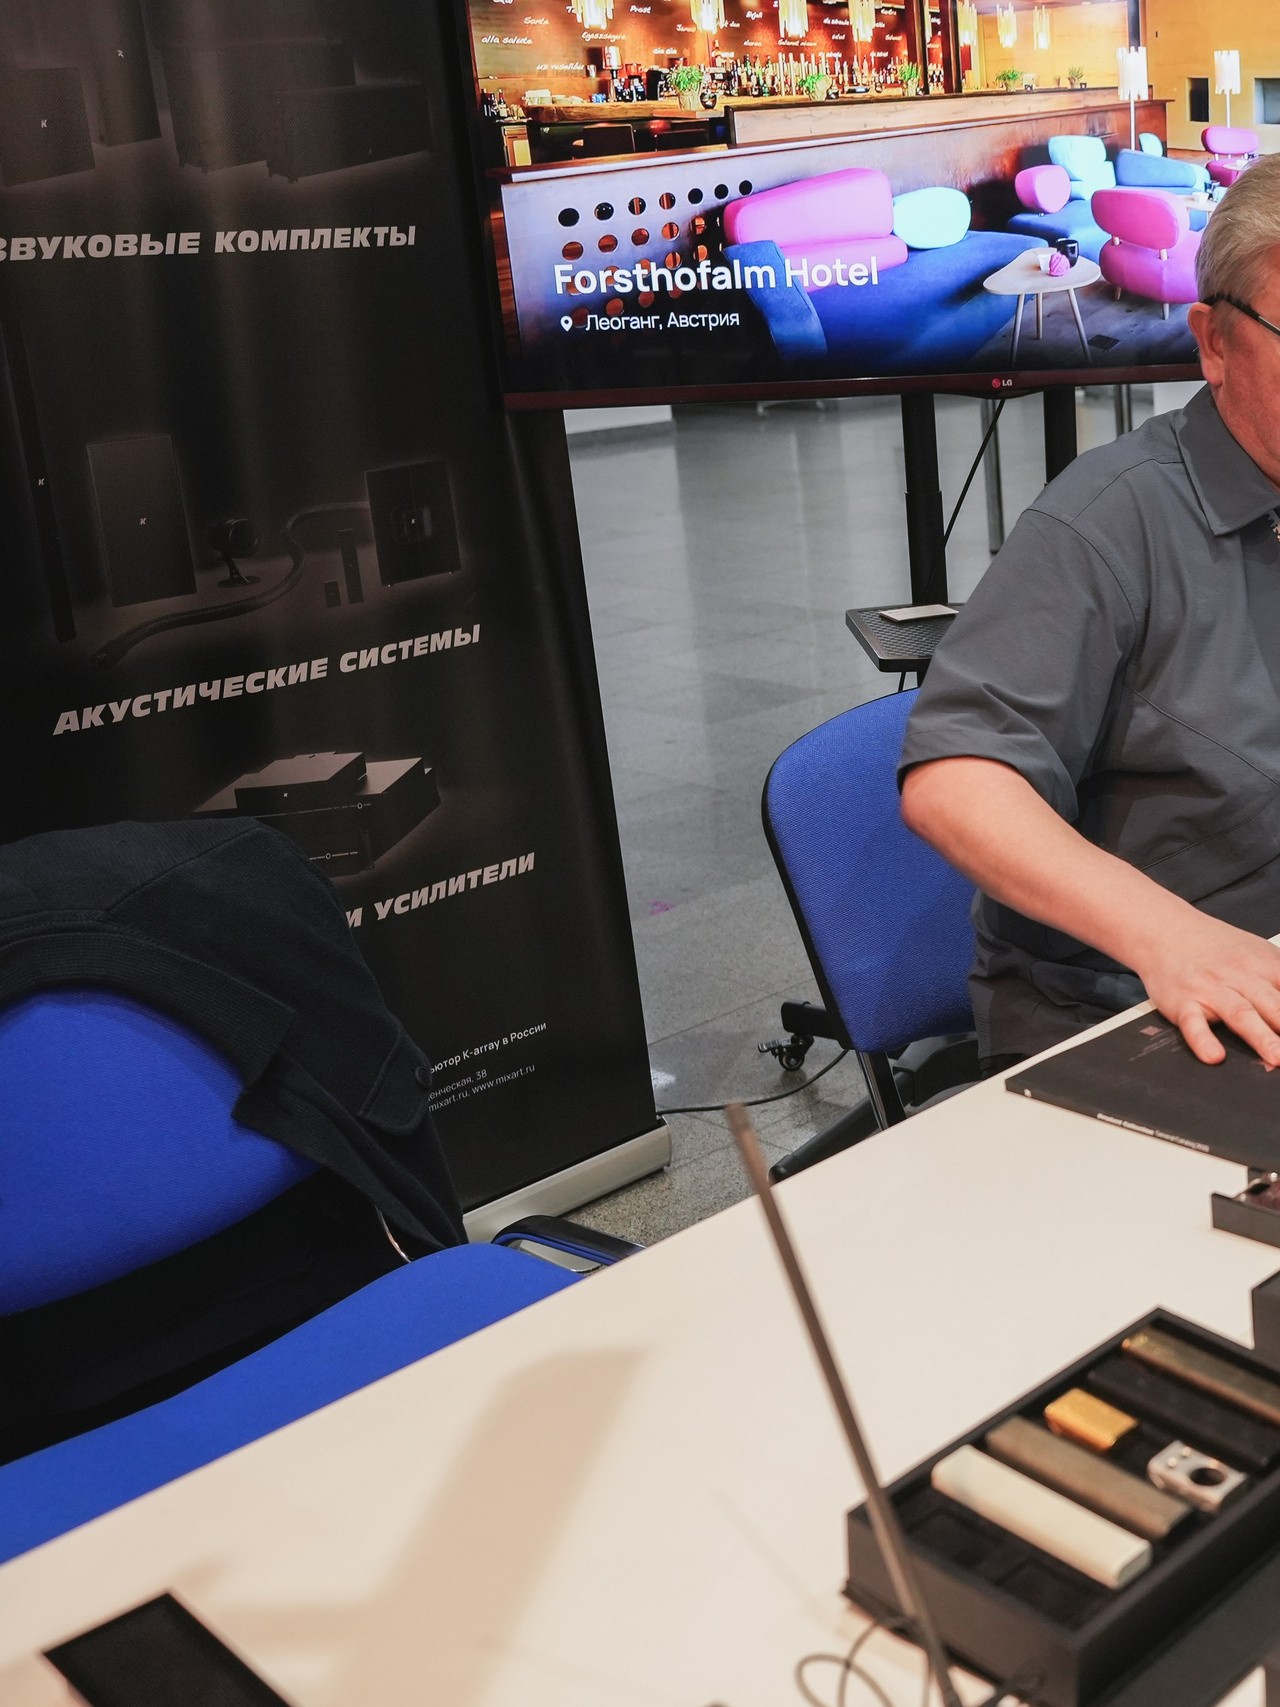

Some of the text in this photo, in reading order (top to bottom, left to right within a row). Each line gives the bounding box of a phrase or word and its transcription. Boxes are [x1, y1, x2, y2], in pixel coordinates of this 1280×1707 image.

[214, 225, 417, 254] КОМПЛЕКТЫ
[554, 256, 879, 295] Forsthofalm Hotel
[585, 311, 740, 331] Леоганг, Австрия
[53, 624, 481, 736] АКУСТИЧЕСКИЕ СИСТЕМЫ
[374, 852, 535, 921] УСИЛИТЕЛИ
[429, 1055, 461, 1074] ьютор
[502, 1037, 509, 1046] в
[510, 1022, 547, 1043] России
[428, 1069, 488, 1101] енческая, 38
[471, 1064, 536, 1095] www.mixart.ru
